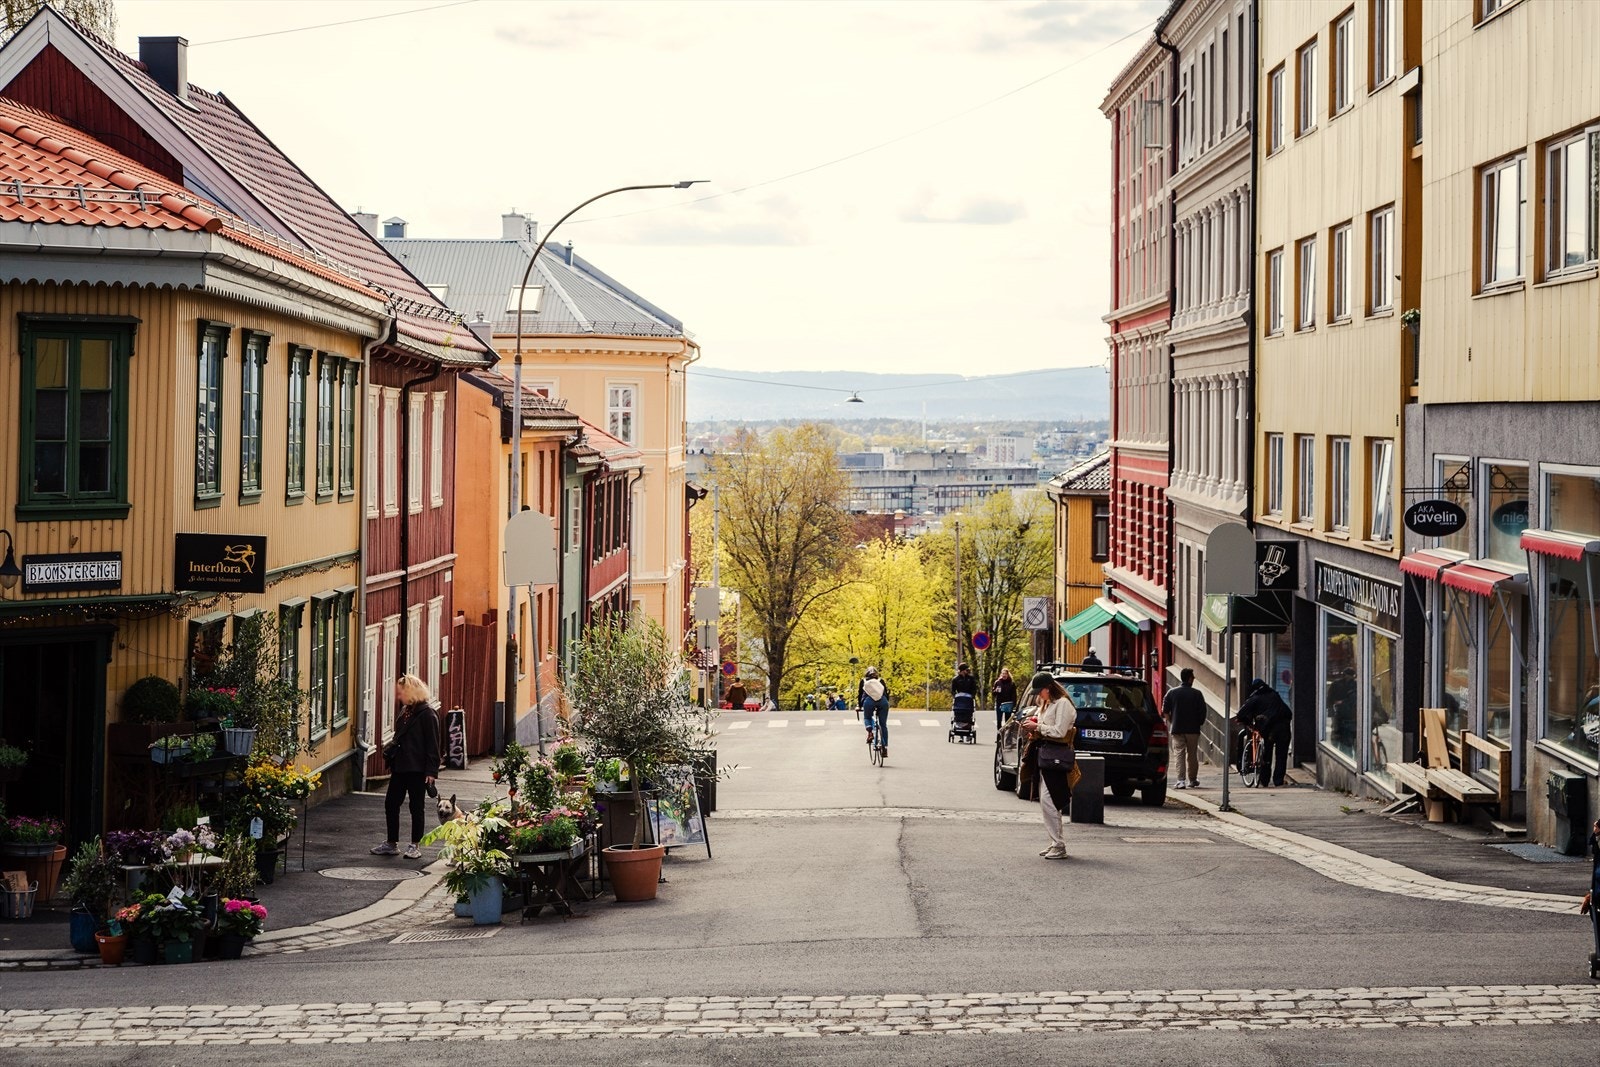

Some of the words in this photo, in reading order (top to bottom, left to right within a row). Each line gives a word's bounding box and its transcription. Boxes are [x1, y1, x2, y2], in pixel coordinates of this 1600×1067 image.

[1418, 505, 1435, 513] AKA
[1413, 511, 1457, 525] javelin
[30, 564, 118, 581] BLOMSTERENGA
[189, 561, 241, 573] Interflora
[1346, 574, 1389, 617] INSTALLASJON
[1389, 588, 1399, 618] AS
[1098, 731, 1122, 739] 83429
